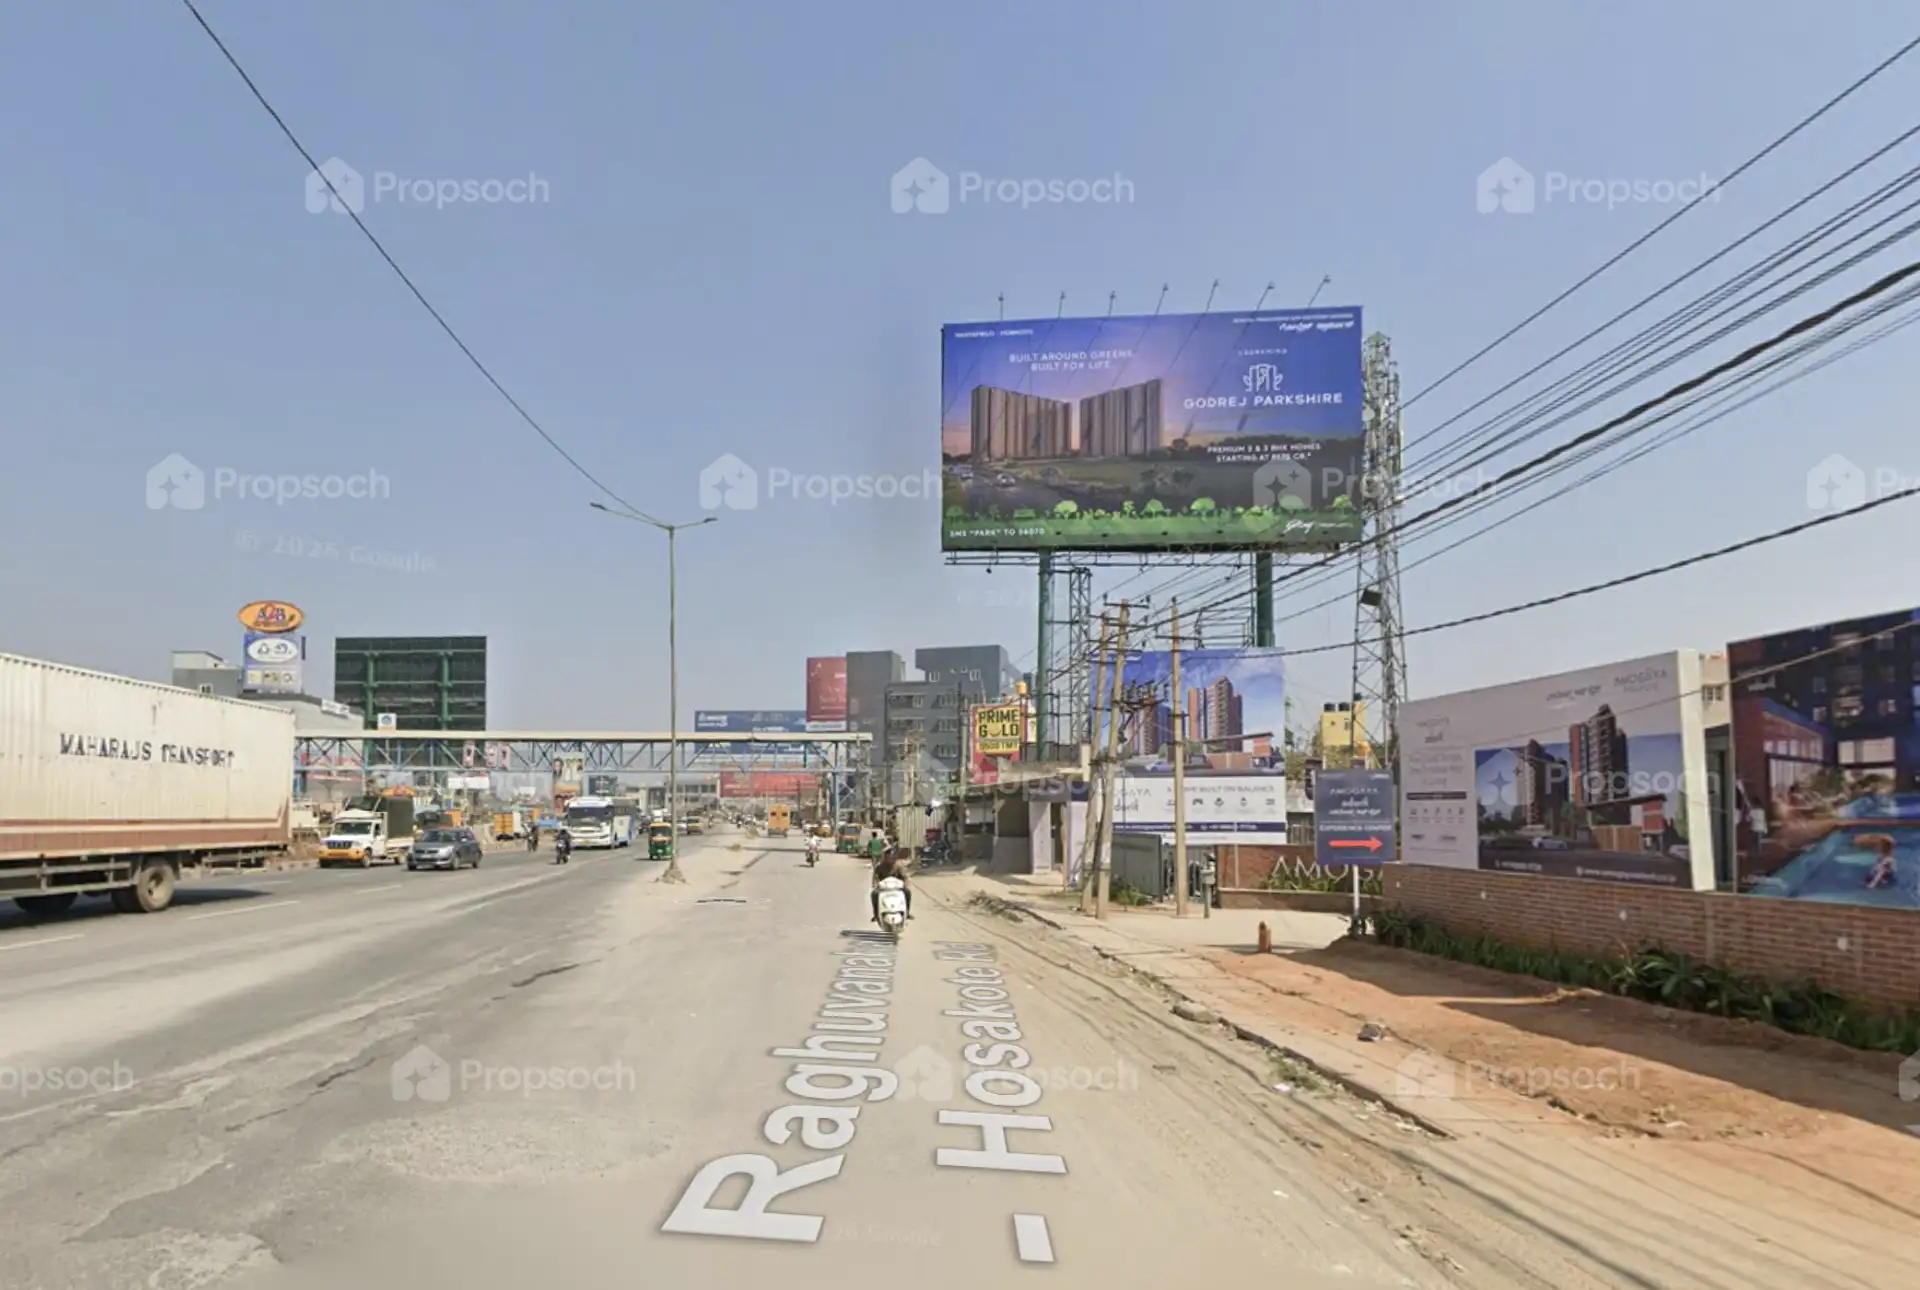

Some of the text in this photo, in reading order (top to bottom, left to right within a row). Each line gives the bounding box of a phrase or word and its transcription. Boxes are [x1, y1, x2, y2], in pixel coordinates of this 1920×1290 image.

[1041, 351, 1087, 361] AROUND
[1183, 392, 1343, 409] GODREJ PARKSHIRE
[1259, 453, 1270, 461] AT
[1003, 528, 1016, 536] TO
[979, 709, 1019, 723] PRIME
